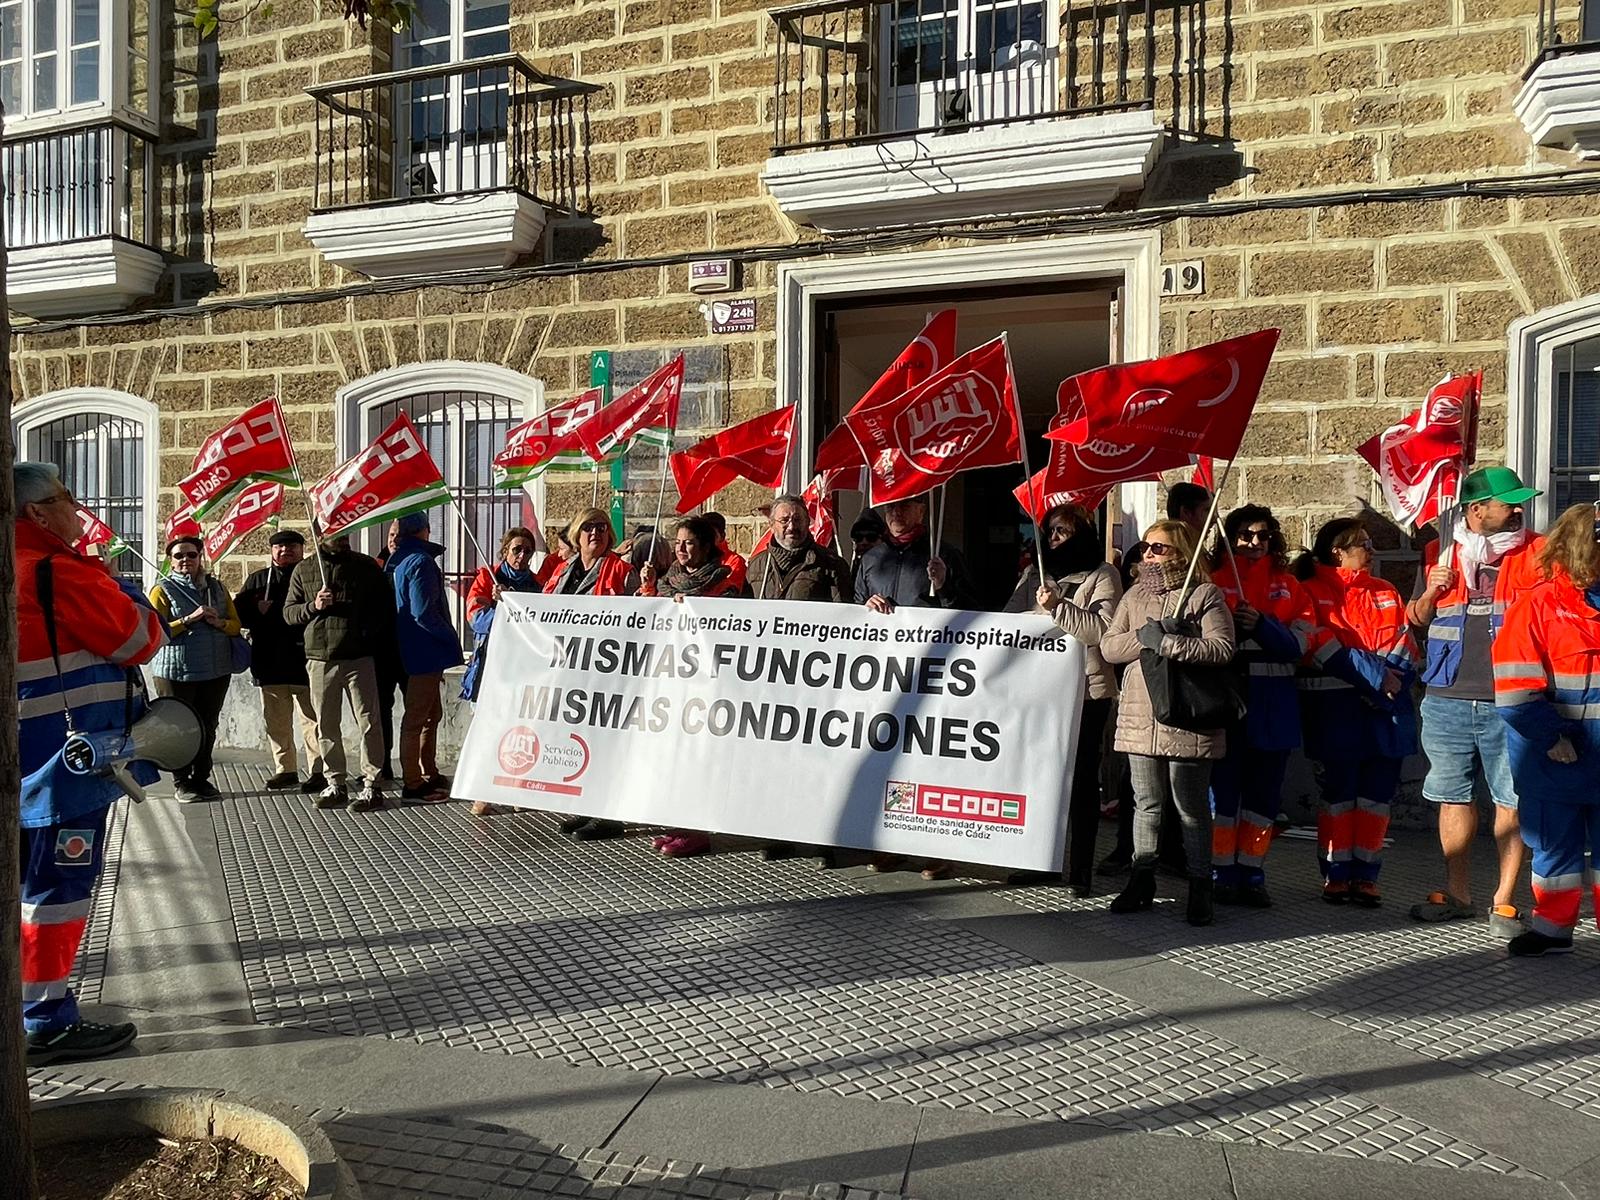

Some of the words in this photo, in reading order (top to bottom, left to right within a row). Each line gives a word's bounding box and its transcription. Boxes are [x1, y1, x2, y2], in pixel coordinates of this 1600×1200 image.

[1162, 266, 1199, 293] 19
[732, 307, 754, 318] 24h
[906, 376, 983, 437] UGT
[525, 607, 536, 622] la
[540, 608, 621, 627] unificación
[626, 611, 646, 629] de
[651, 613, 673, 631] las
[678, 614, 752, 635] Urgencias
[755, 619, 768, 637] y
[773, 617, 889, 643] Emergencias
[895, 624, 1067, 653] extrahospitalarias
[550, 635, 701, 679] MISMAS
[709, 643, 977, 697] FUNCIONES
[518, 684, 671, 733] MISMAS
[681, 697, 1001, 762] CONDICIONES
[503, 733, 536, 755] UGT
[544, 743, 583, 757] Servicios
[542, 754, 579, 769] Públicos
[923, 791, 1000, 817] CCOO
[883, 820, 950, 836] sociosanitarios
[952, 828, 964, 838] de
[965, 829, 991, 840] Cádiz
[884, 812, 924, 824] sindicato
[926, 817, 938, 826] de
[940, 818, 976, 830] sanidad
[977, 822, 983, 831] y
[984, 824, 1024, 836] sectores
